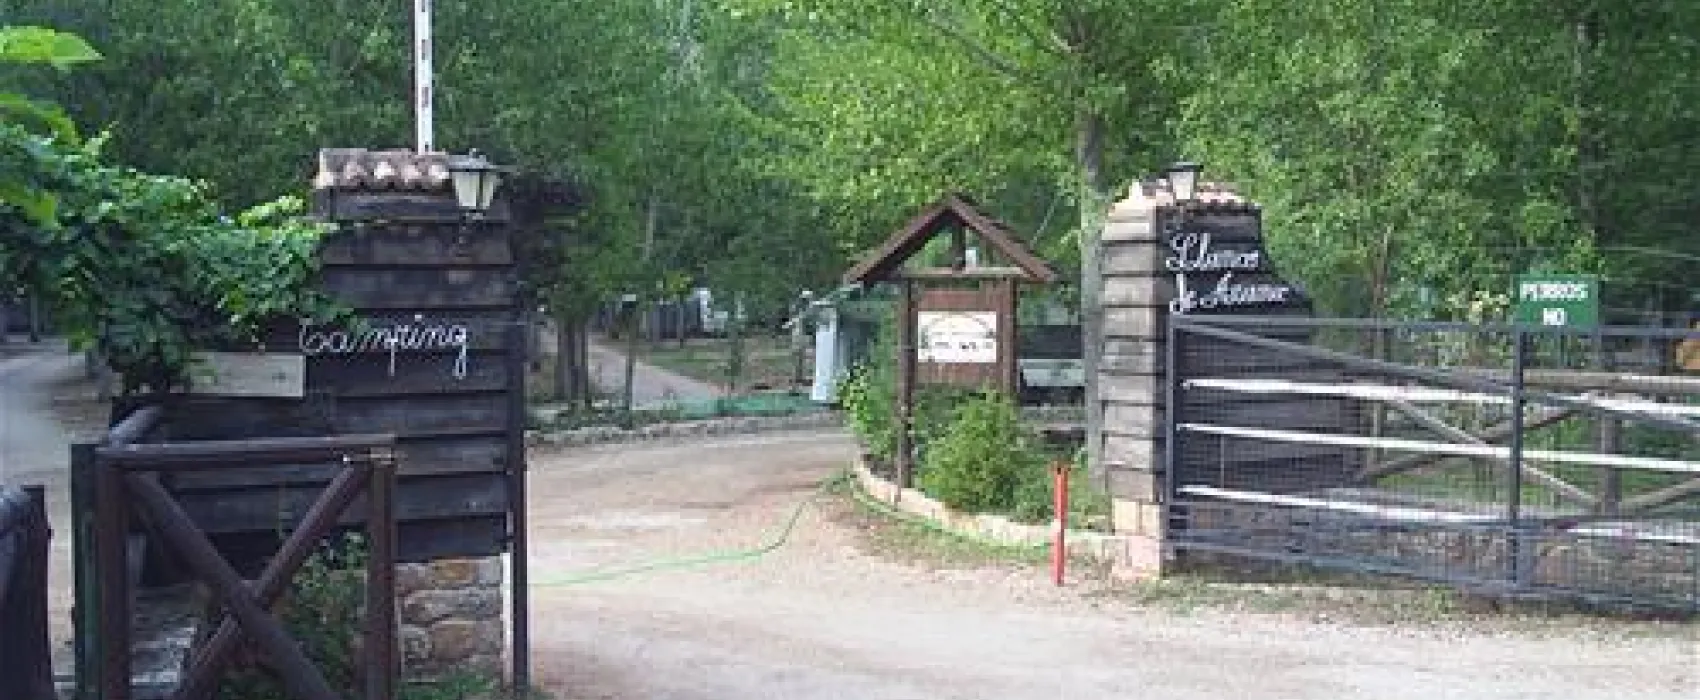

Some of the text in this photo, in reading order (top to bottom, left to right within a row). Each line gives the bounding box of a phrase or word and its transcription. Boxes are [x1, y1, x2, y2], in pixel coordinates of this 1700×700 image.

[1169, 273, 1197, 315] de
[1520, 281, 1589, 301] PERROS
[1543, 308, 1567, 326] NO
